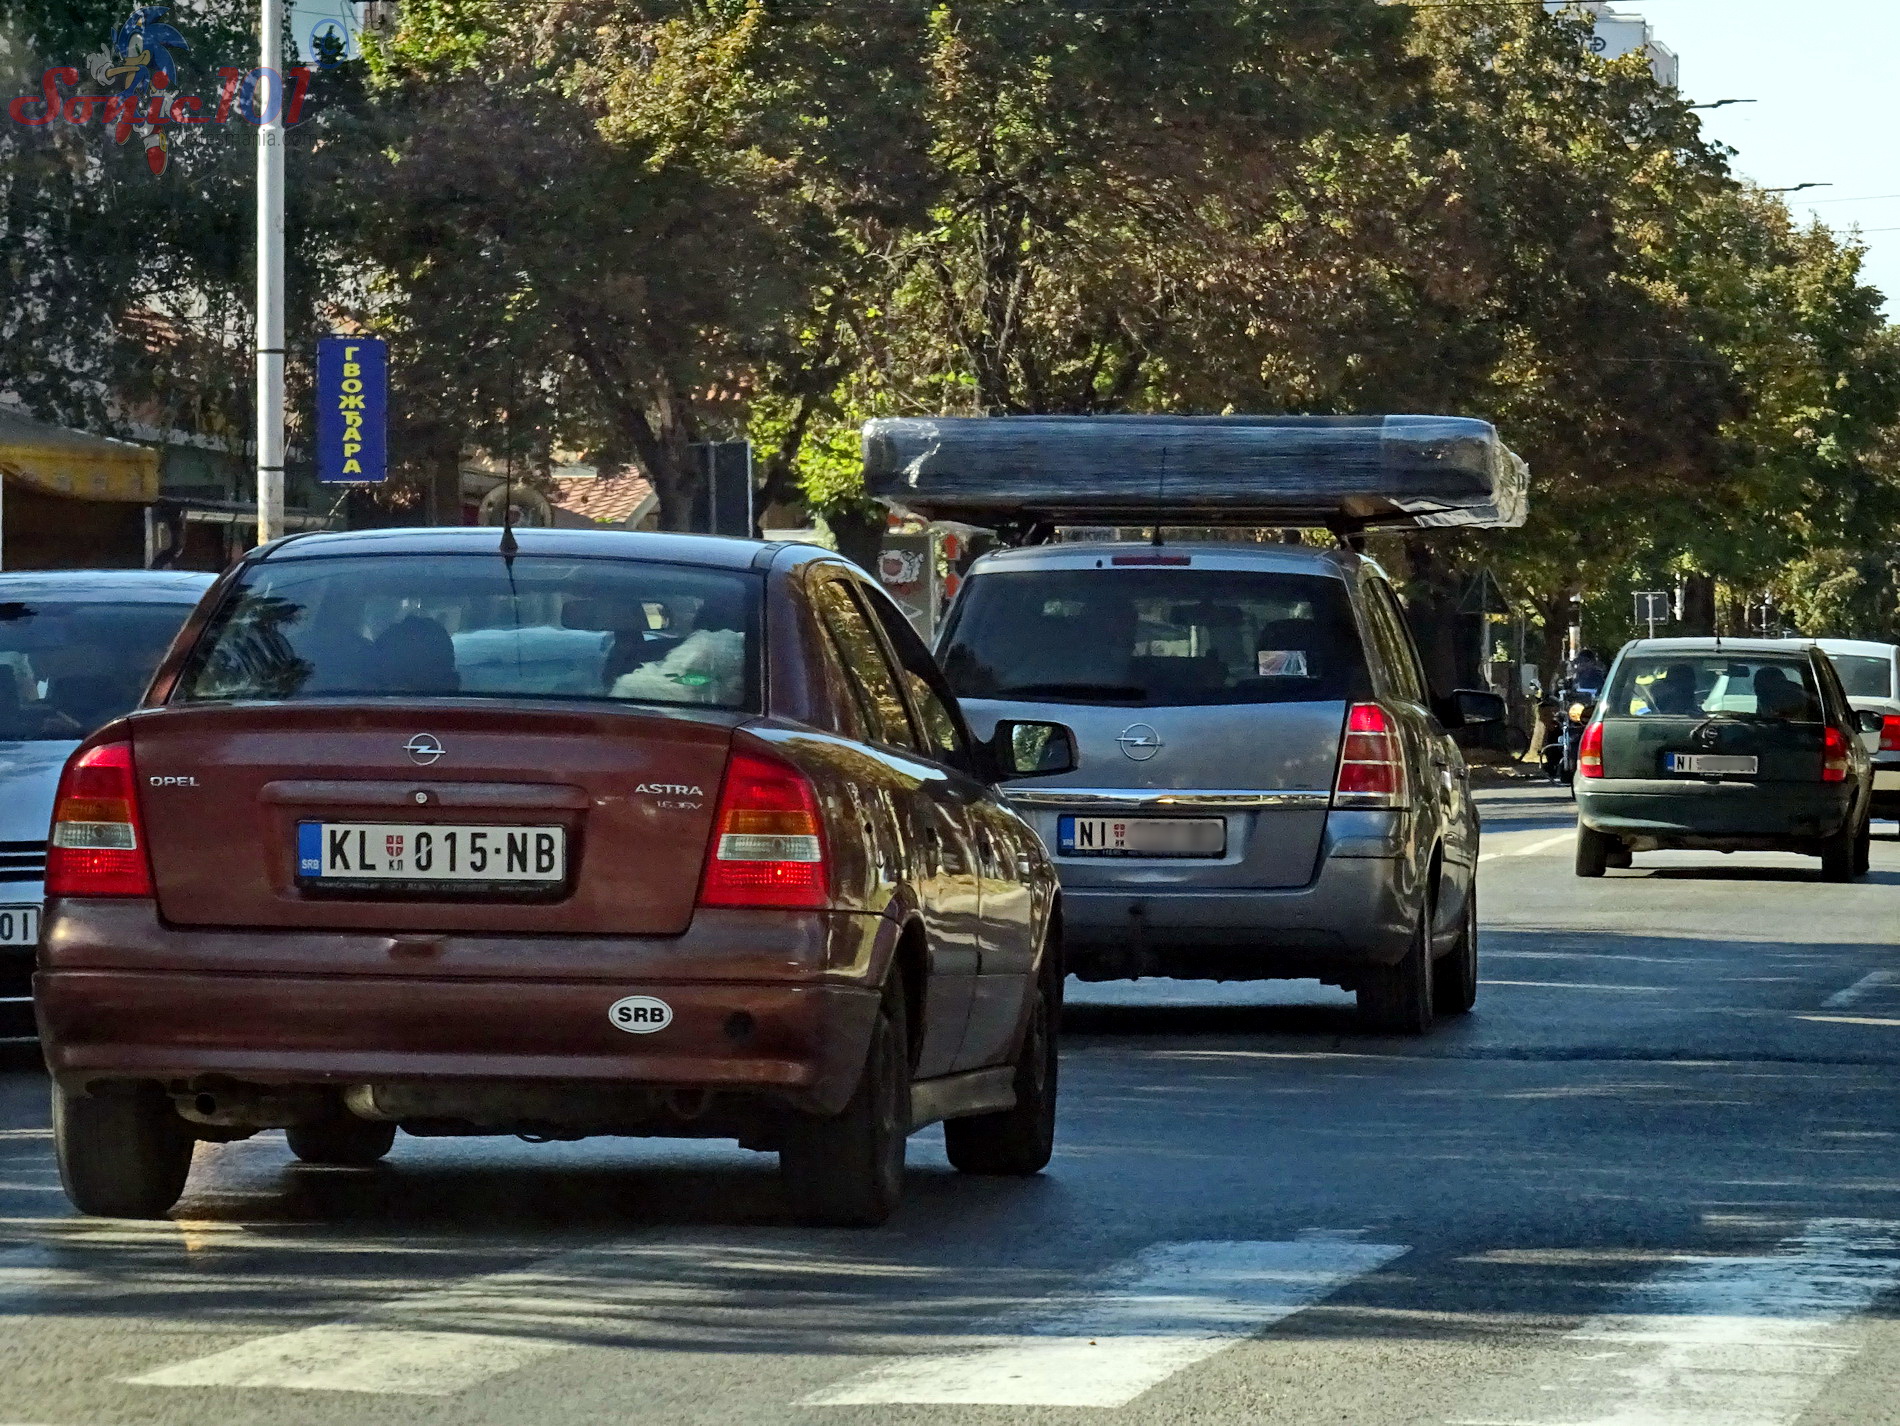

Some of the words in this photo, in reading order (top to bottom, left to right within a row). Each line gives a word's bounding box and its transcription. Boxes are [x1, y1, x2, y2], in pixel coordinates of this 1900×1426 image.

[338, 346, 366, 473] ГВОЖЂАРА
[150, 776, 200, 787] OPEL
[634, 783, 704, 796] ASTRA
[1080, 822, 1105, 847] NI
[329, 829, 377, 871] KL
[302, 858, 319, 870] SRB
[618, 1006, 664, 1023] SRB
